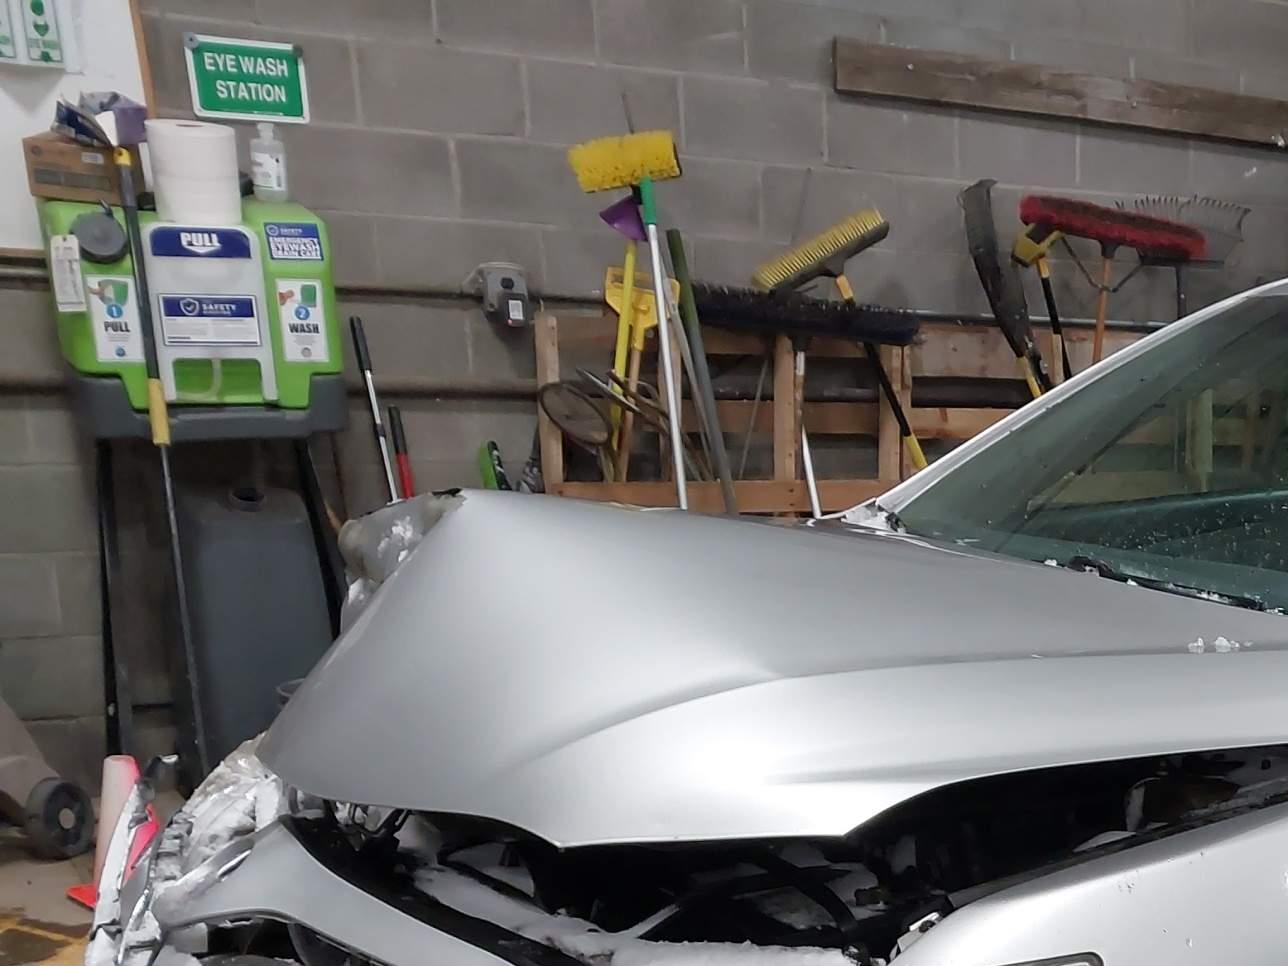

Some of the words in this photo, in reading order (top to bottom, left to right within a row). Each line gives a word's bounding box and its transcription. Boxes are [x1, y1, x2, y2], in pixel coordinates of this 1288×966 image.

[203, 52, 238, 73] EYE
[239, 55, 288, 78] WASH
[216, 80, 286, 103] STATION
[180, 232, 220, 247] PULL
[202, 303, 236, 311] SAFETY
[103, 321, 131, 333] PULL
[288, 323, 320, 334] WASH
